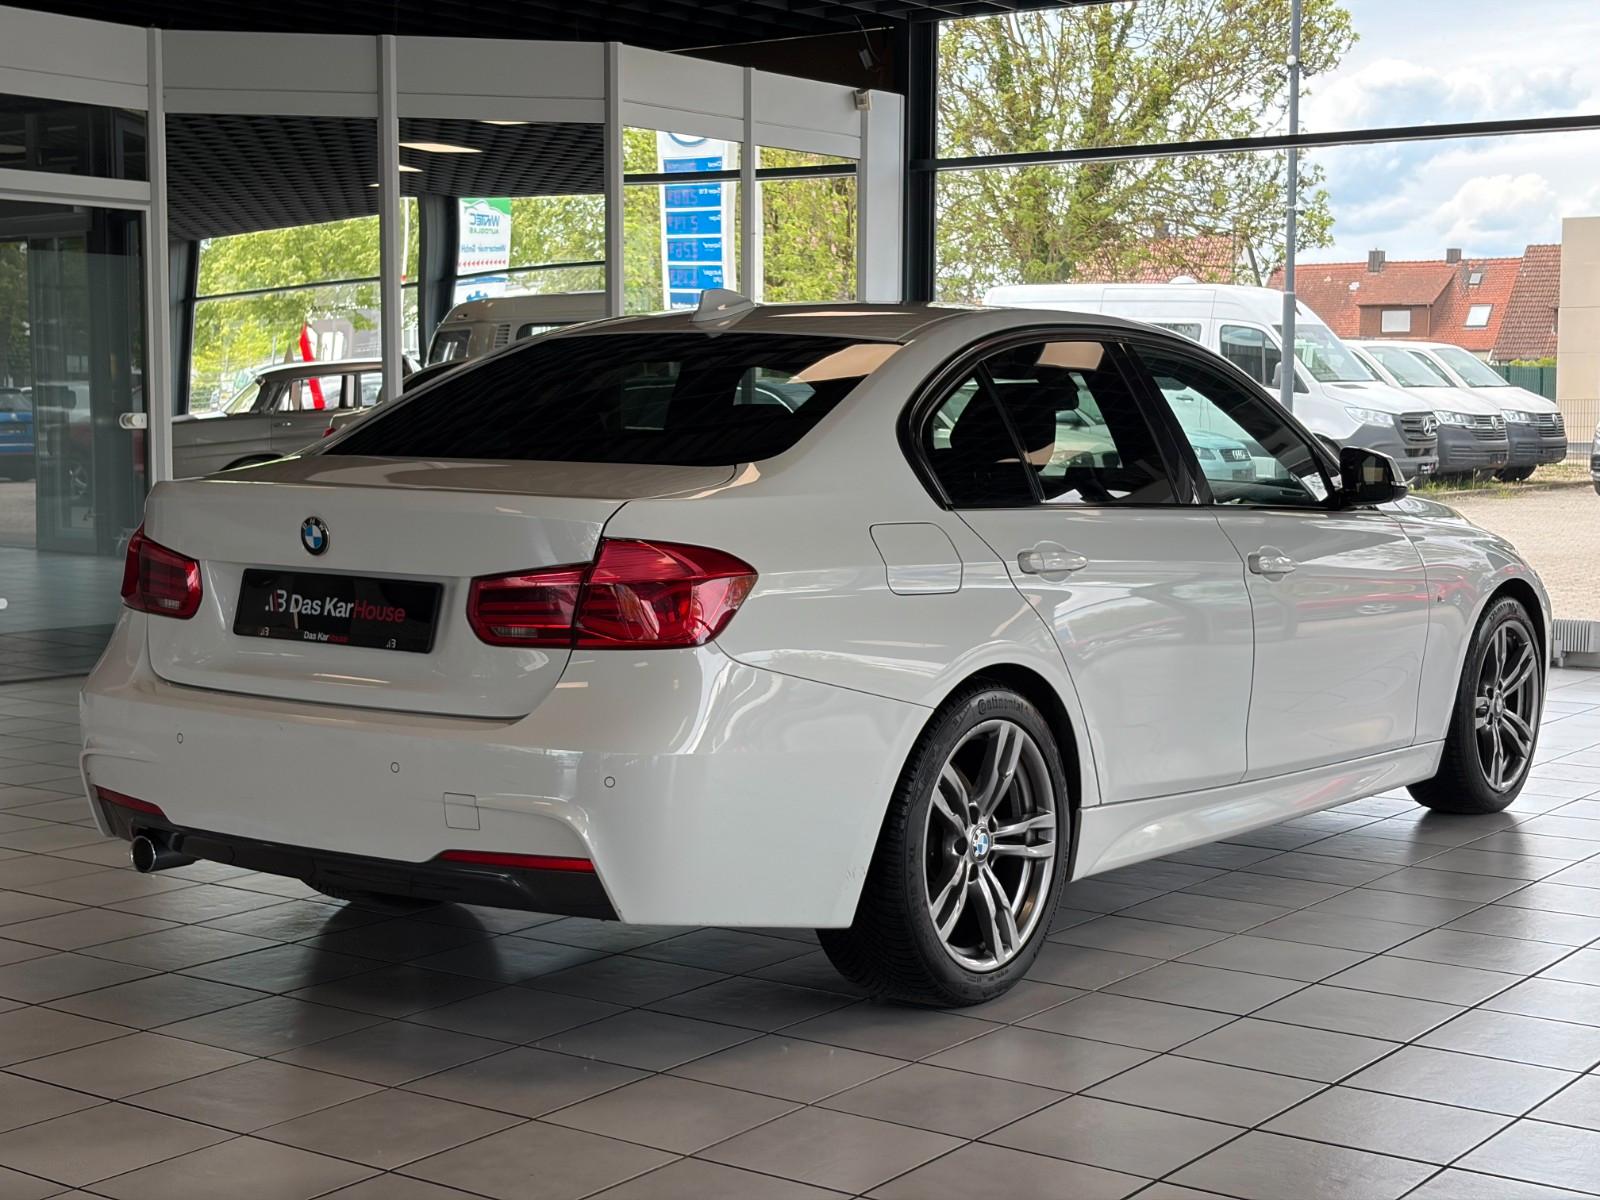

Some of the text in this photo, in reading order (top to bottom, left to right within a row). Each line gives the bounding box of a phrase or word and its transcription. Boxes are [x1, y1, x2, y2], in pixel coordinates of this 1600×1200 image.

[289, 594, 321, 615] Das
[323, 596, 407, 623] KarHouse
[303, 630, 316, 640] Das
[977, 695, 1024, 716] Continental
